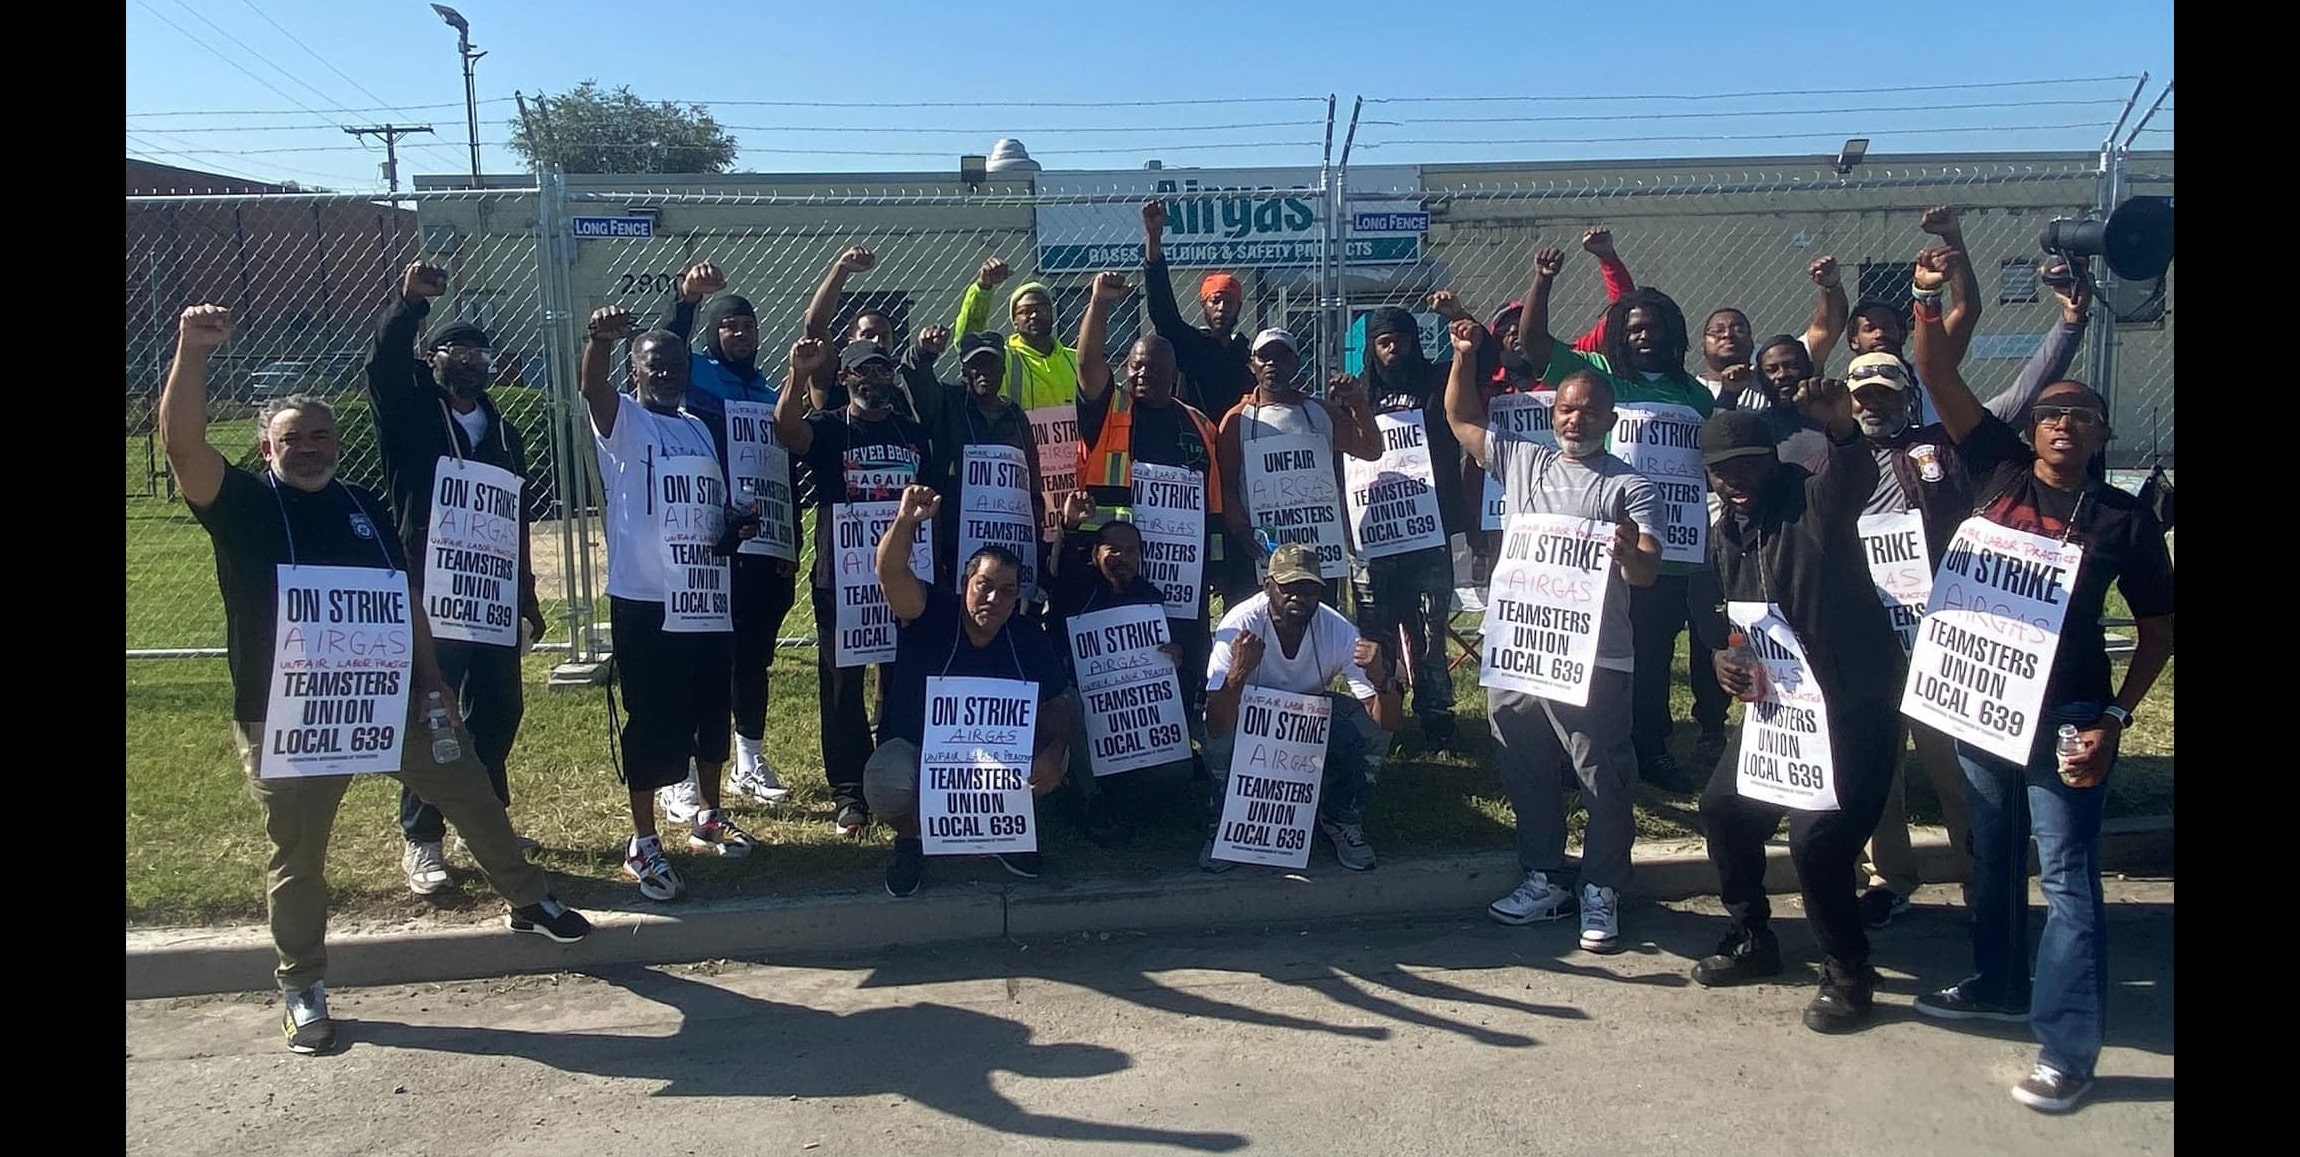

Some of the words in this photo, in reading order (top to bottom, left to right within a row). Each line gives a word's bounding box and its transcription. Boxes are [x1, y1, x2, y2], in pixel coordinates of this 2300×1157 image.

[1156, 180, 1314, 237] Airgas
[1355, 214, 1387, 231] LONG
[1389, 213, 1428, 231] FENCE
[576, 219, 608, 235] LONG
[610, 220, 649, 235] FENCE
[1160, 245, 1217, 262] ELDING
[1221, 246, 1232, 260] &
[1237, 243, 1291, 259] SAFETY
[1295, 241, 1373, 258] PROCTS
[732, 416, 756, 442] ON
[1032, 423, 1049, 446] ON
[1053, 420, 1079, 444] STR
[1514, 407, 1554, 433] STRI
[1619, 419, 1644, 443] ON
[1383, 424, 1423, 450] TRIKE
[968, 460, 992, 486] ON
[1263, 449, 1316, 473] UNFAIR
[663, 475, 691, 504] ON
[1041, 474, 1079, 492] TEAMST
[1149, 482, 1200, 511] STRIKE
[1253, 472, 1335, 500] AIRGAS
[1353, 477, 1429, 508] TEAMSTERS
[1658, 482, 1701, 504] STERS
[440, 476, 469, 509] ON
[474, 482, 518, 522] STRIKE
[1370, 498, 1418, 523] UNION
[438, 508, 519, 548] AIRGAS
[664, 505, 722, 532] AIRG
[758, 519, 777, 540] CAL
[1044, 511, 1064, 528] LOC
[1258, 505, 1334, 527] TEAMSTERS
[1359, 524, 1403, 545] LOCAL
[1406, 514, 1436, 536] 639
[840, 520, 864, 549] ON
[967, 519, 1033, 543] TEAMSTERS
[1280, 525, 1320, 545] UNION
[1667, 527, 1698, 546] 639
[843, 547, 932, 575] AIAS
[1142, 541, 1197, 563] MSTERS
[1315, 544, 1343, 563] 639
[1507, 532, 1532, 561] ON
[1535, 533, 1607, 572] STRIKE
[1860, 530, 1920, 565] TRIKE
[436, 547, 514, 581] TEAMSTERS
[1143, 561, 1180, 582] NION
[1946, 536, 1976, 577] ON
[1975, 547, 2068, 606] STRIKE
[452, 573, 501, 603] UNION
[687, 567, 721, 590] UNION
[1509, 568, 1593, 603] AIRGAS
[287, 588, 320, 623] ON
[329, 589, 406, 624] STRIKE
[672, 591, 710, 614] LOCAL
[1163, 583, 1194, 603] 639
[430, 595, 482, 623] LOCAL
[486, 603, 512, 627] 639
[1498, 598, 1592, 635] TEAMSTERS
[1943, 583, 2050, 644] AIRGAS
[284, 626, 407, 656] AIRGAS
[843, 626, 891, 650] LOCAL
[1076, 629, 1101, 660] ON
[1104, 618, 1166, 654] STRIKE
[1514, 626, 1570, 656] UNION
[1928, 617, 2040, 681] TEAMSTERS
[280, 658, 330, 670] UNFAIR
[336, 658, 373, 669] LABOR
[1090, 652, 1151, 675] AIRGAS
[1490, 647, 1545, 677] LOCAL
[1551, 658, 1585, 684] 639
[1940, 652, 2008, 701] UNION
[284, 671, 400, 697] TEAMSTERS
[1088, 680, 1174, 715] TEAMSTERS
[303, 699, 375, 726] UNION
[932, 696, 958, 727] ON
[964, 696, 1031, 727] STRIKE
[1913, 670, 1971, 719] LOCAL
[1979, 699, 2026, 738] 639
[1108, 704, 1161, 734] UNION
[1244, 705, 1271, 737] ON
[1275, 711, 1328, 745] STRIKE
[273, 727, 343, 756] LOCAL
[350, 725, 396, 752] 639
[950, 728, 1017, 743] AIRGAS
[1094, 732, 1146, 759] LOCAL
[1150, 723, 1183, 749] 639
[1758, 727, 1801, 760] UNION
[1250, 743, 1318, 774] AIRGAS
[1743, 751, 1784, 783] LOCAL
[1788, 761, 1824, 790] 639
[929, 767, 1022, 790] TEAMSTERS
[1236, 774, 1314, 804] TEAMSTERS
[947, 792, 1005, 814] UNION
[1247, 800, 1296, 826] UNION
[928, 816, 985, 837] LOCAL
[989, 815, 1027, 836] 639
[1223, 821, 1271, 847] LOCAL
[1276, 828, 1306, 850] 639
